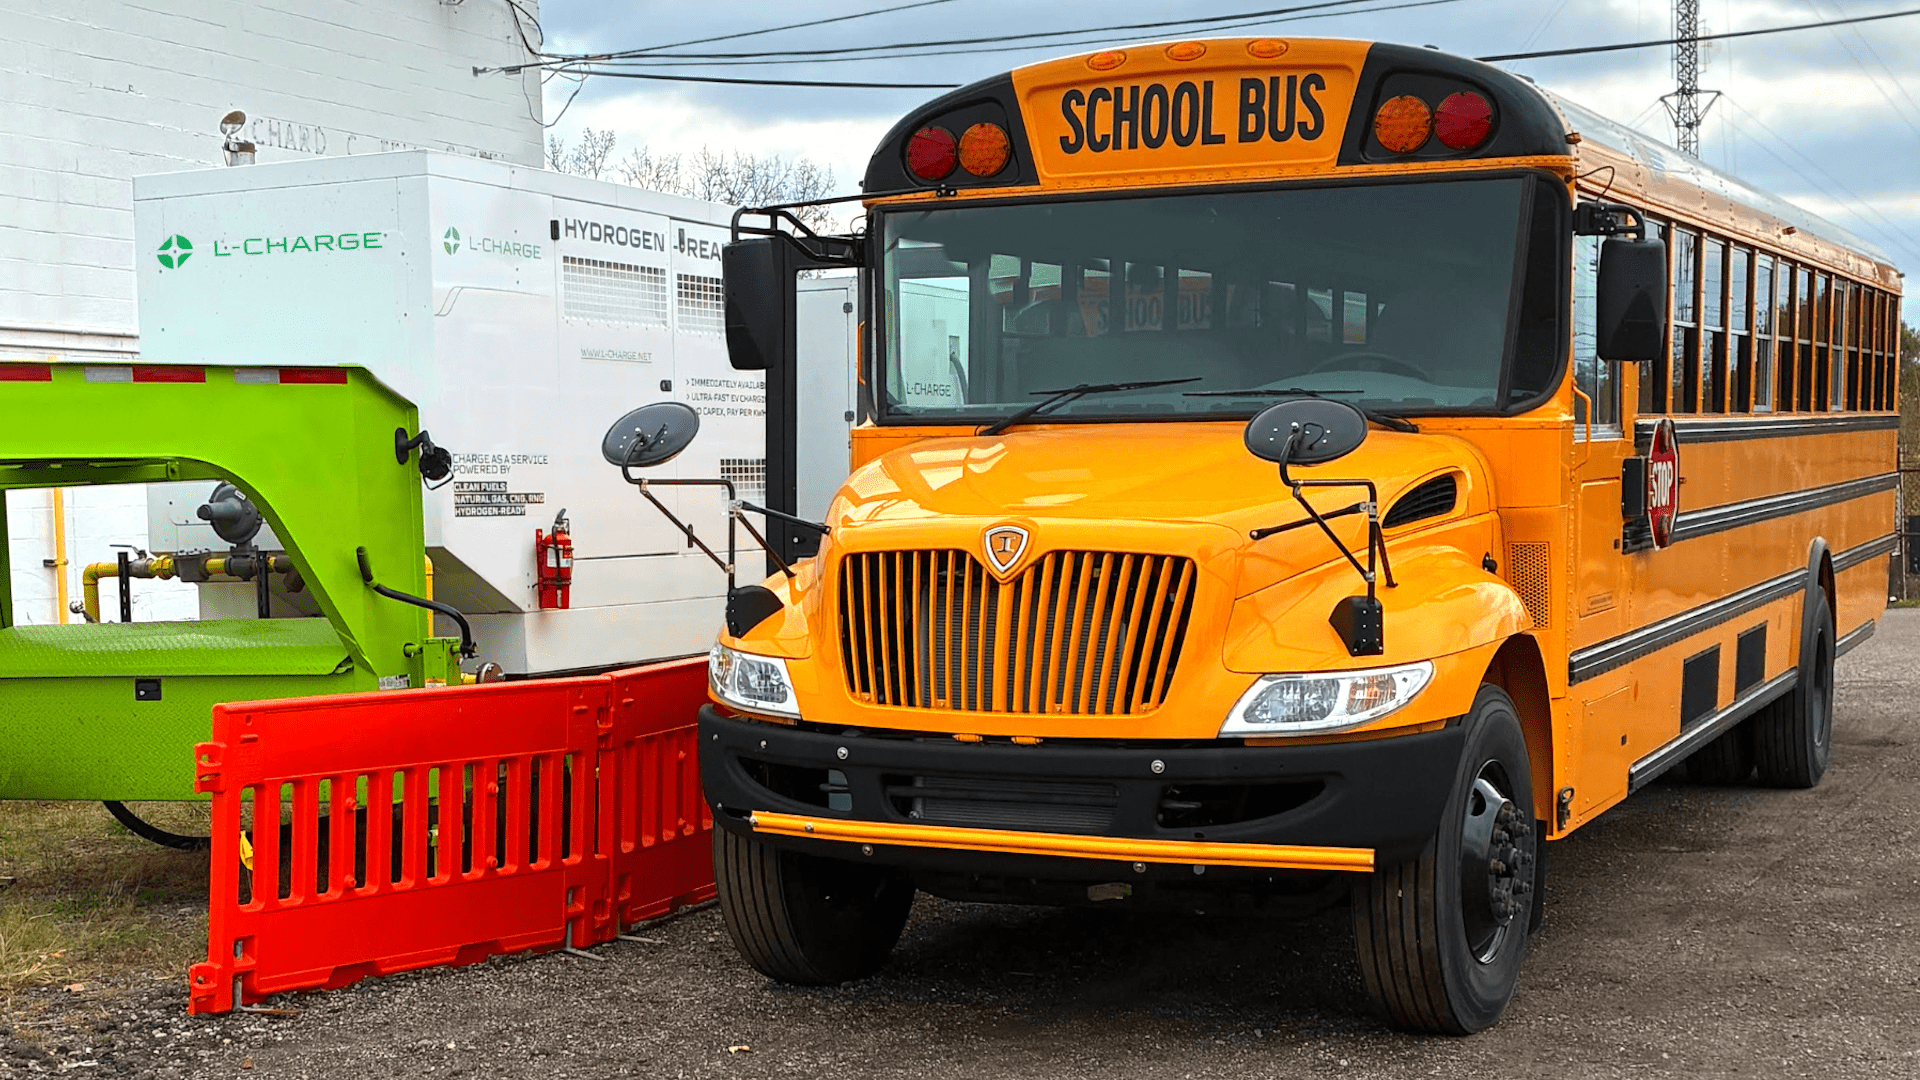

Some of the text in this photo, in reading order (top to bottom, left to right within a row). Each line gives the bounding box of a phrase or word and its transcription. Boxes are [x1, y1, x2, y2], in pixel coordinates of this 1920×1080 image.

[1059, 73, 1326, 155] SCHOOL BUS
[214, 232, 383, 257] L-CHARGE
[564, 217, 722, 262] HYDROGEN -REA
[469, 235, 542, 260] L-CHARGE
[738, 380, 766, 390] AVAILAB
[906, 381, 951, 397] L-CHARGE
[740, 393, 766, 404] CHARGI
[726, 407, 739, 417] PAY
[739, 408, 753, 417] PER
[452, 453, 549, 465] CHARGE AS A SERVICE
[453, 464, 511, 474] POWERED BY
[454, 482, 480, 492] CLEAN
[1651, 460, 1674, 508] STOP
[455, 494, 491, 504] NATURAL
[455, 506, 526, 517] HYDROGEN-READY
